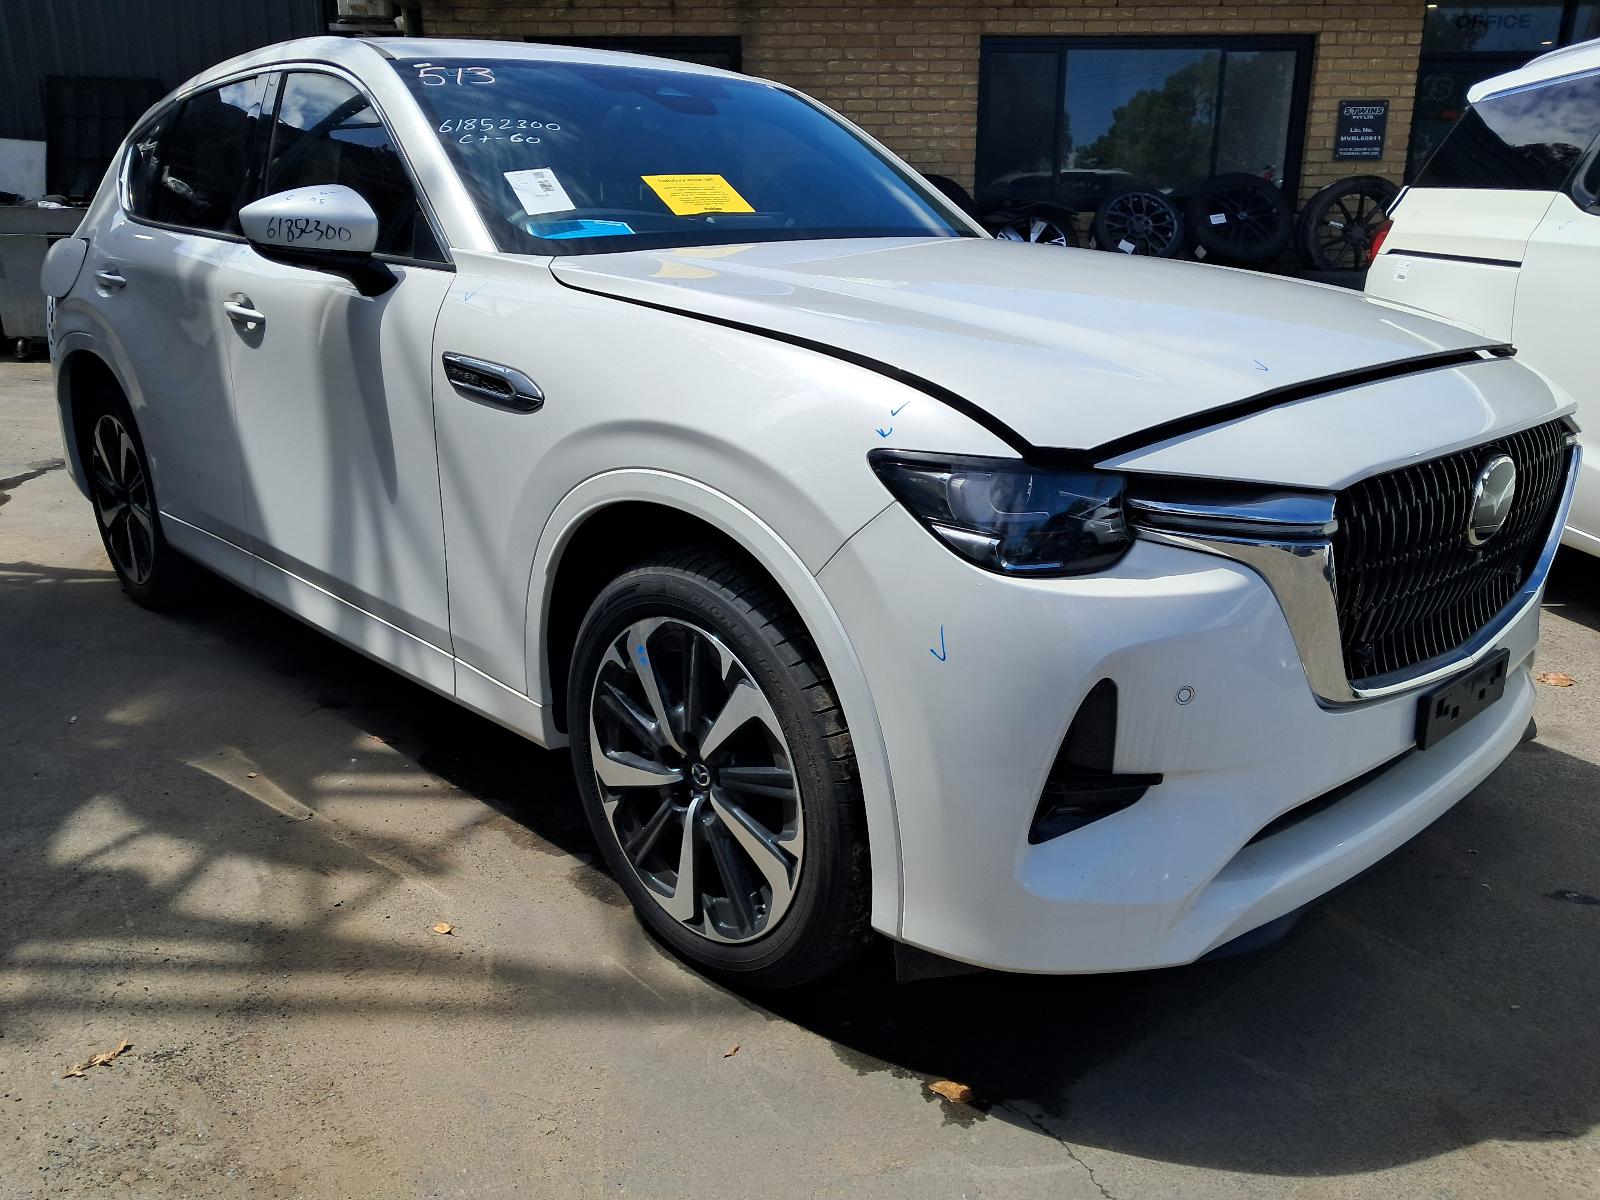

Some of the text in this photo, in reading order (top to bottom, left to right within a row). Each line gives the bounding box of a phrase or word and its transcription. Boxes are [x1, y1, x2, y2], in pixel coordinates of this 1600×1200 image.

[1456, 14, 1532, 29] OFFICE
[412, 63, 496, 86] 513
[438, 118, 561, 133] 61852300
[267, 217, 352, 242] 61852300
